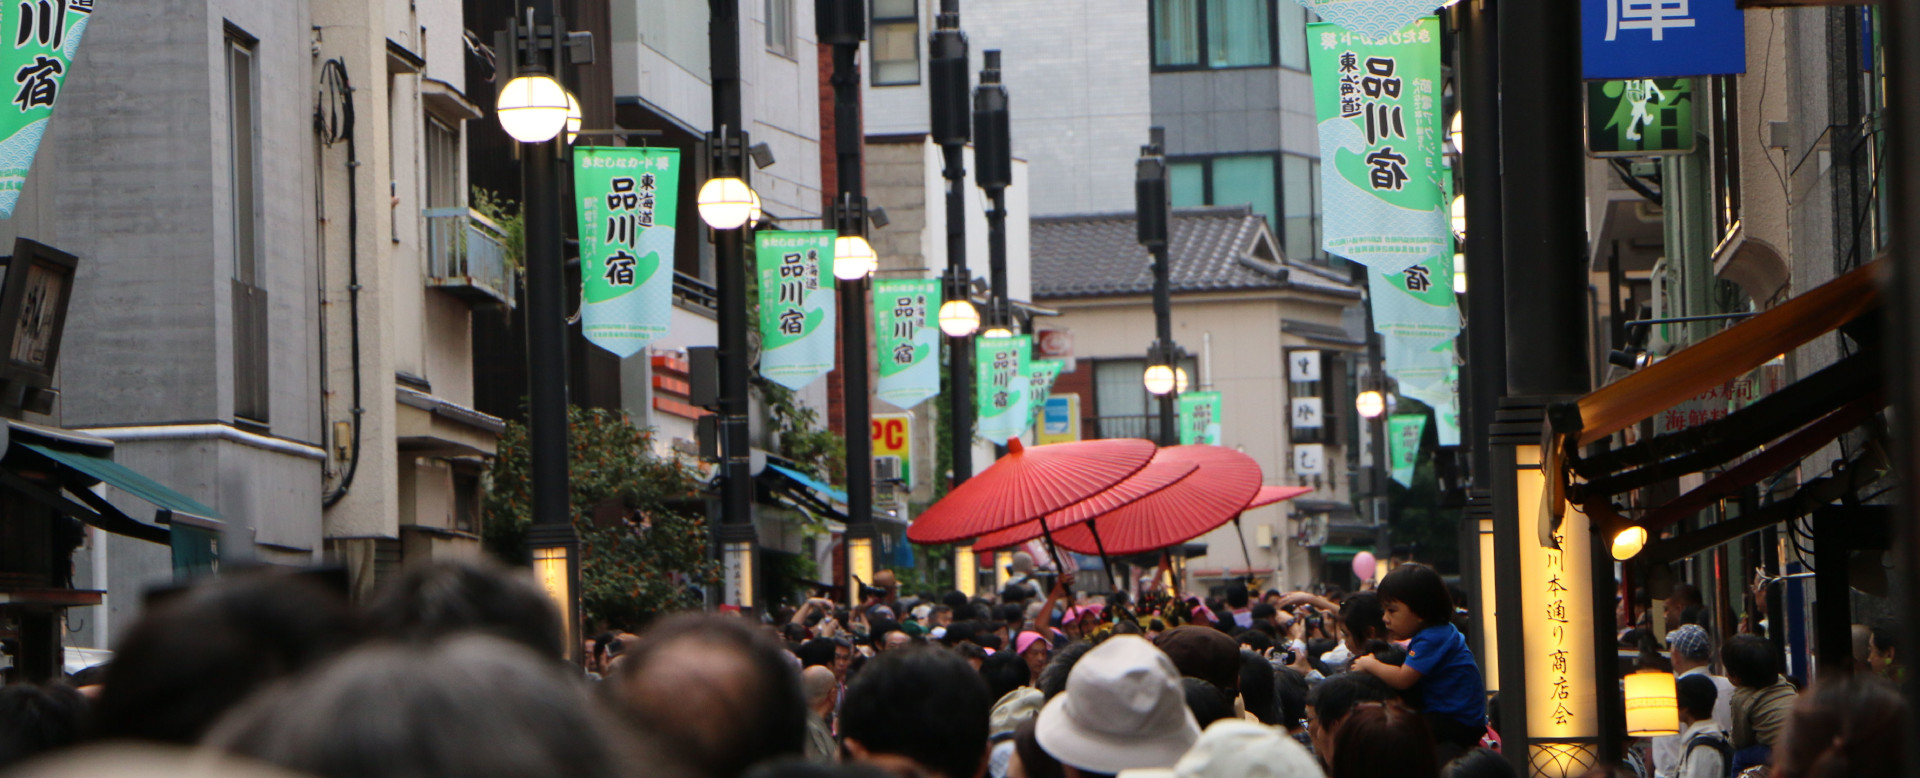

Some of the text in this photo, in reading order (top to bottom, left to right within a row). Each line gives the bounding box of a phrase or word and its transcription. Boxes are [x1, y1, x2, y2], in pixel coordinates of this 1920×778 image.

[604, 177, 637, 285] 品川宿
[639, 173, 655, 228] 東海道
[779, 252, 804, 335] 品川宿
[806, 249, 818, 290] 東海道
[894, 297, 914, 364] 品川宿
[993, 352, 1009, 408] 品川宿
[1692, 379, 1753, 401] み寿司
[1546, 532, 1575, 725] 川本通り商店会
